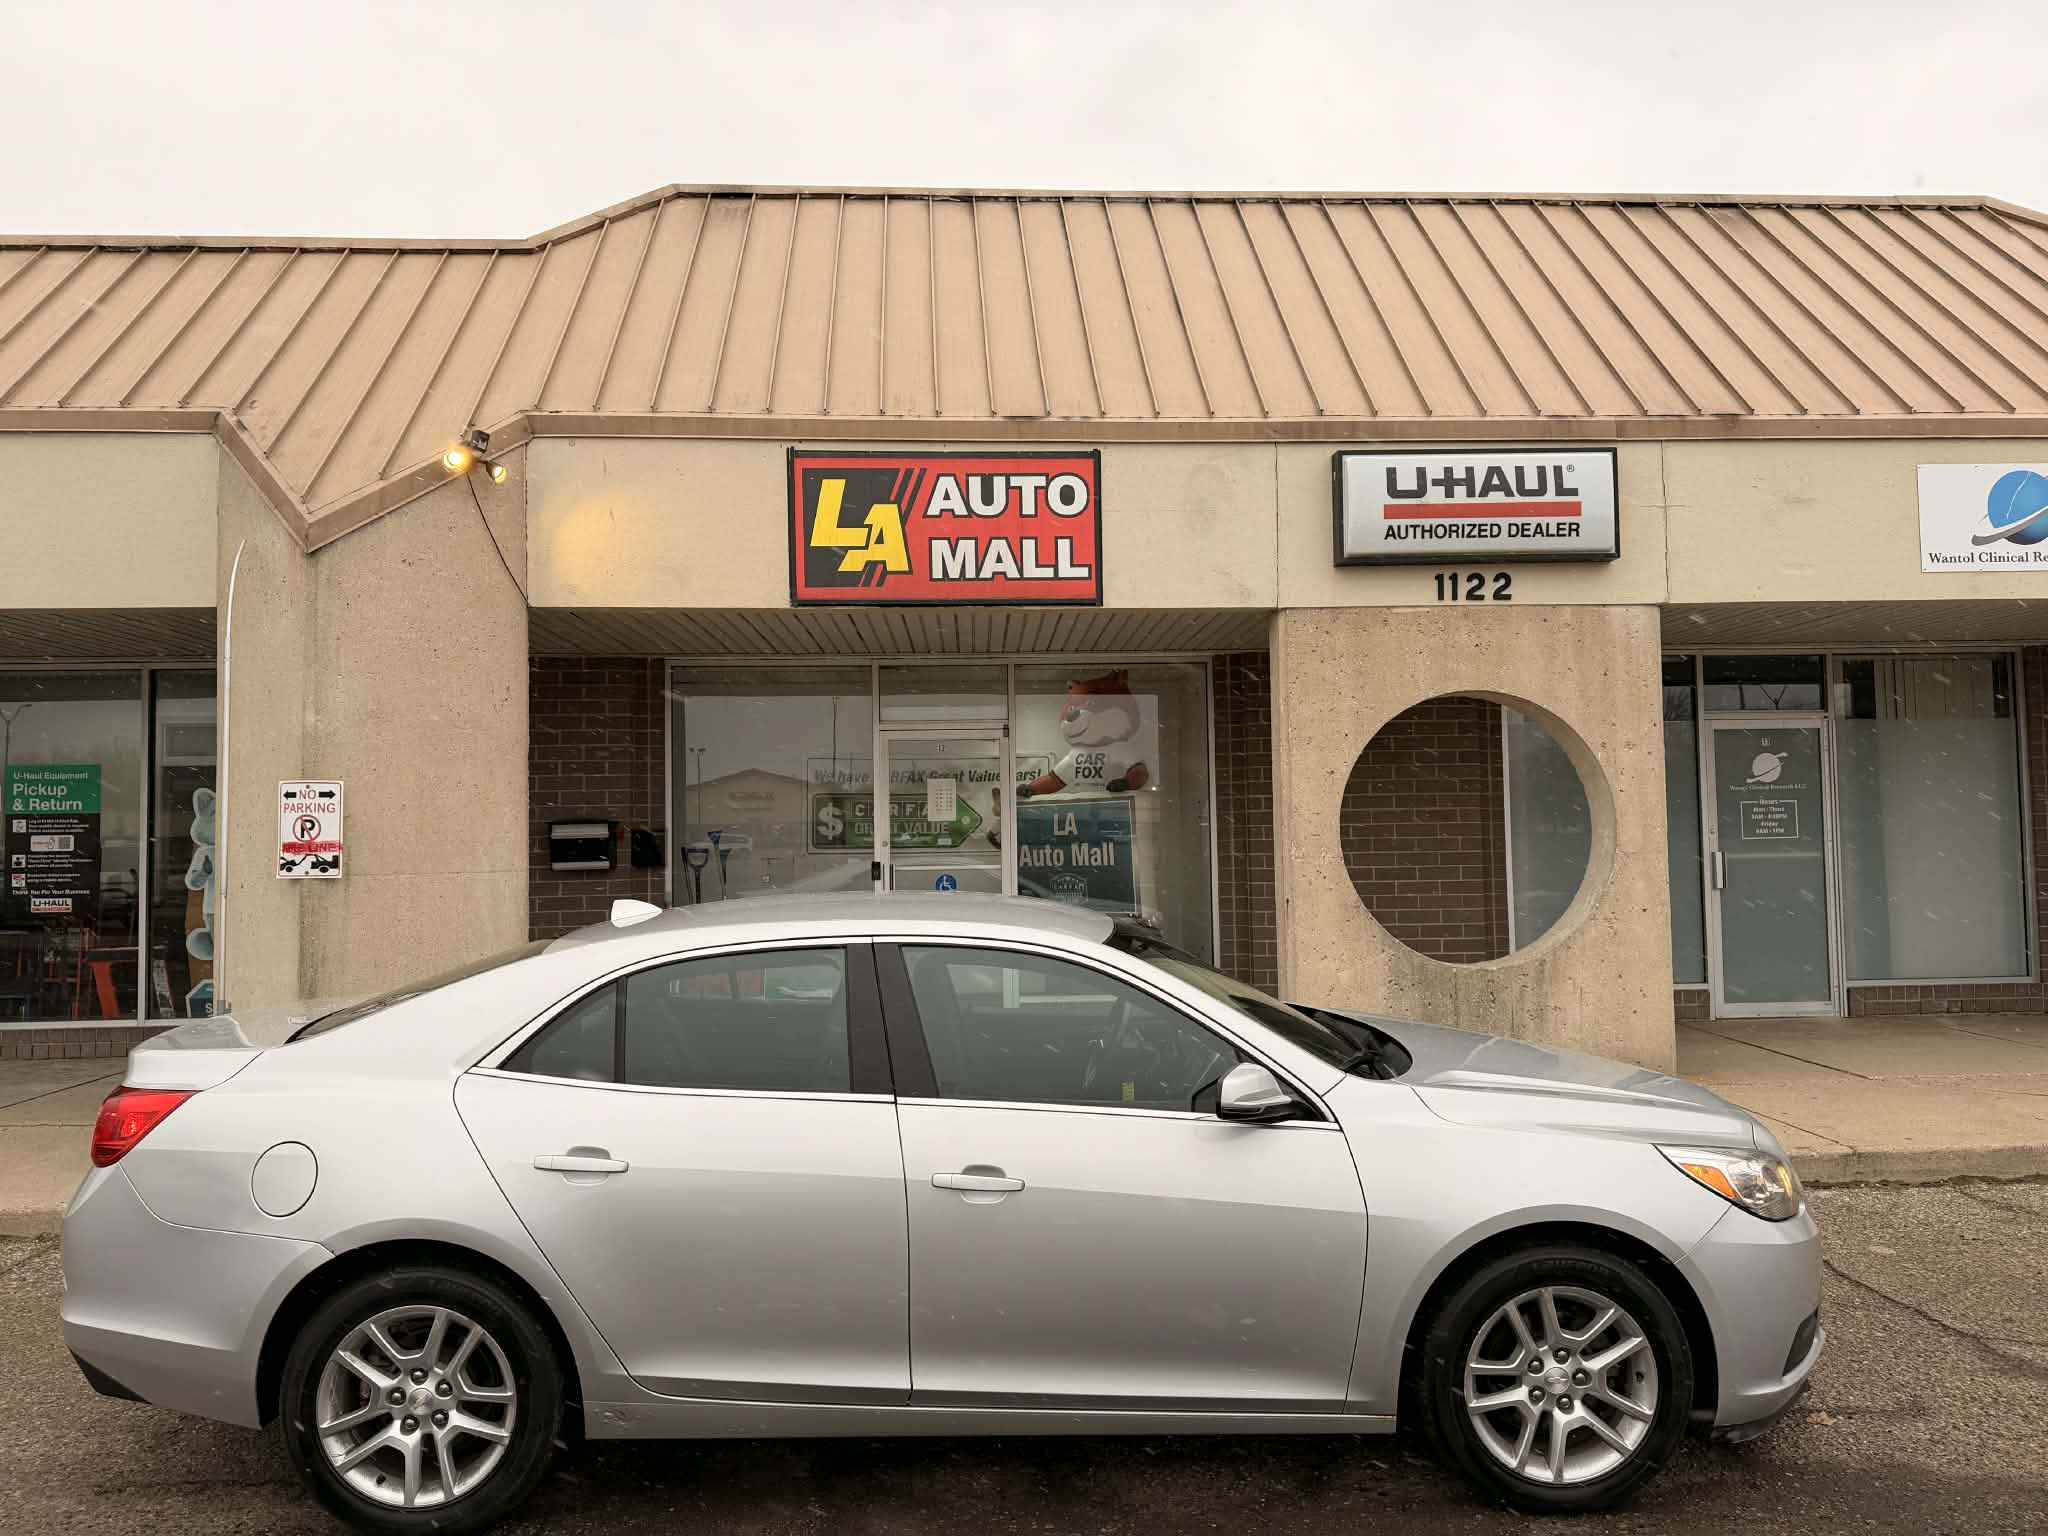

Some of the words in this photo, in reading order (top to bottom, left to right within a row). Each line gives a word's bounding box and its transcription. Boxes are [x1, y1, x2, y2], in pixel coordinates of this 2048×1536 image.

[924, 473, 1089, 517] AUTO
[809, 478, 911, 572] LA
[1384, 523, 1501, 540] AUTHORIZED
[1507, 522, 1581, 539] DEALER
[929, 537, 1091, 581] MALL
[1928, 552, 1975, 563] Wantol
[1978, 551, 2029, 563] Clinical
[1434, 571, 1512, 601] 1122
[1075, 752, 1105, 765] CAR
[1015, 768, 1041, 781] ars!
[1074, 766, 1104, 779] FOX
[13, 783, 68, 797] Pickup
[299, 789, 317, 800] NO
[13, 798, 25, 811] &
[29, 798, 83, 811] Return
[283, 802, 336, 813] PARKING
[1053, 812, 1078, 836] LA
[1019, 844, 1065, 867] Auto
[1071, 842, 1116, 867] Mall
